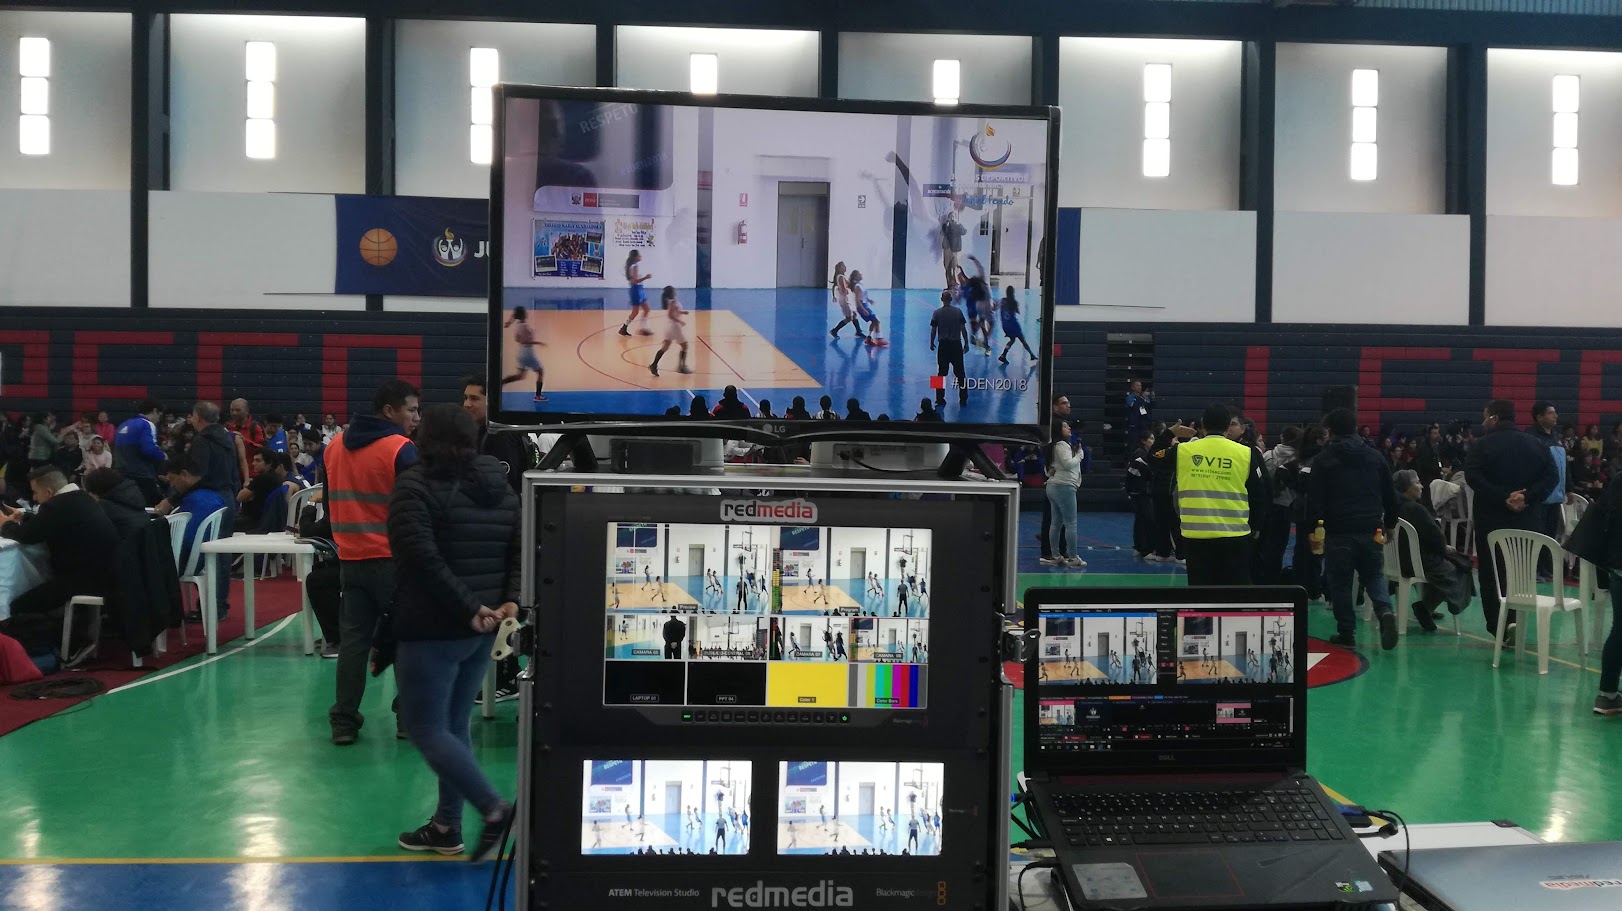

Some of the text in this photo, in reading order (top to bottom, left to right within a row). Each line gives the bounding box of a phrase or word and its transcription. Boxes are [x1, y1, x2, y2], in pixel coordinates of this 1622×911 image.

[579, 104, 638, 134] RESPETO
[474, 241, 490, 258] J
[951, 377, 1027, 391] #JDEN2018
[774, 425, 786, 433] LG
[1205, 456, 1233, 469] V13
[724, 501, 813, 518] redmedia
[608, 889, 700, 897] ATEM Television Studio
[711, 880, 854, 908] redmedia
[876, 887, 914, 899] Blackmagic
